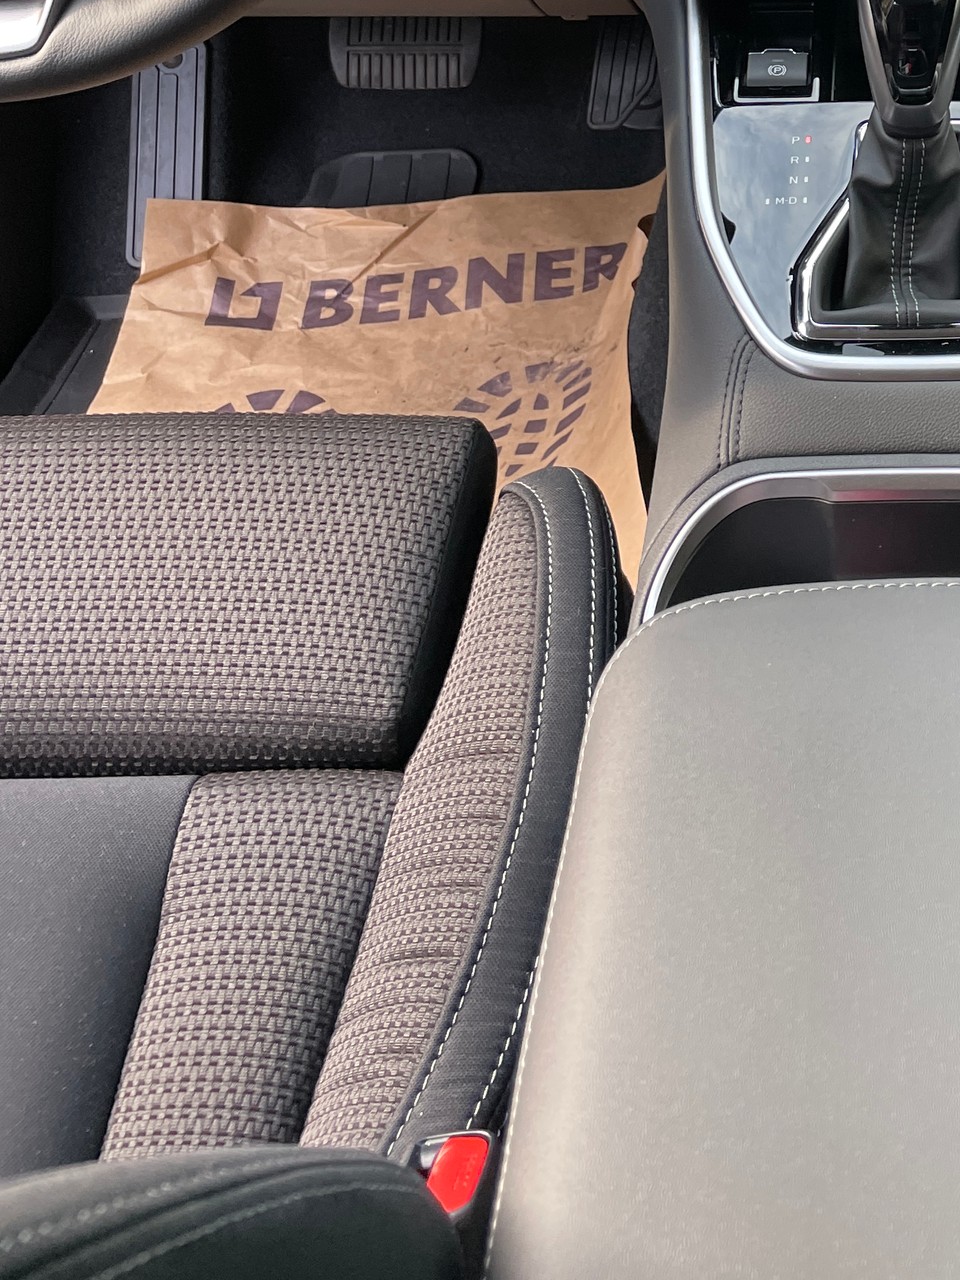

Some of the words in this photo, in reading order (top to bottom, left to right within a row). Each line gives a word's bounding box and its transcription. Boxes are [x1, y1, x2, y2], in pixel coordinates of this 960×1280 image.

[791, 136, 800, 145] P
[790, 156, 799, 164] R
[789, 176, 798, 184] N
[300, 242, 628, 330] BERNER
